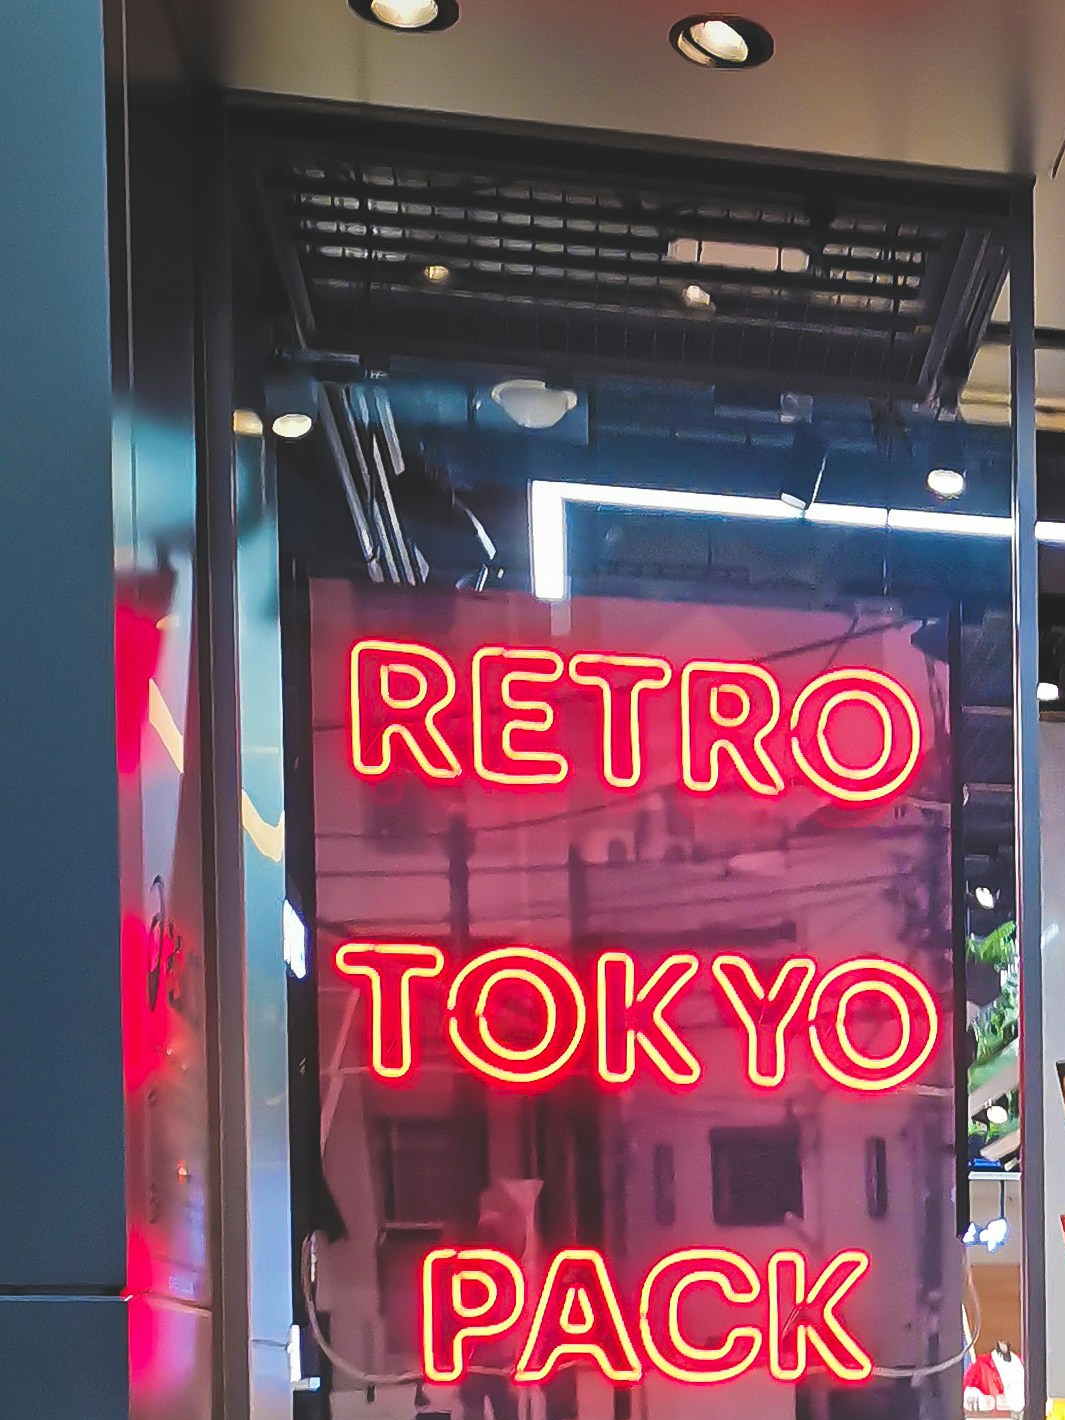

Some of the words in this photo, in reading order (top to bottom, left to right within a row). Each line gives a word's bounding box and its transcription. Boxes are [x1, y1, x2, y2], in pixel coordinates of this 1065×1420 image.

[350, 640, 922, 802] RETRO
[336, 942, 939, 1092] TOKYO
[422, 1247, 873, 1384] PACK
